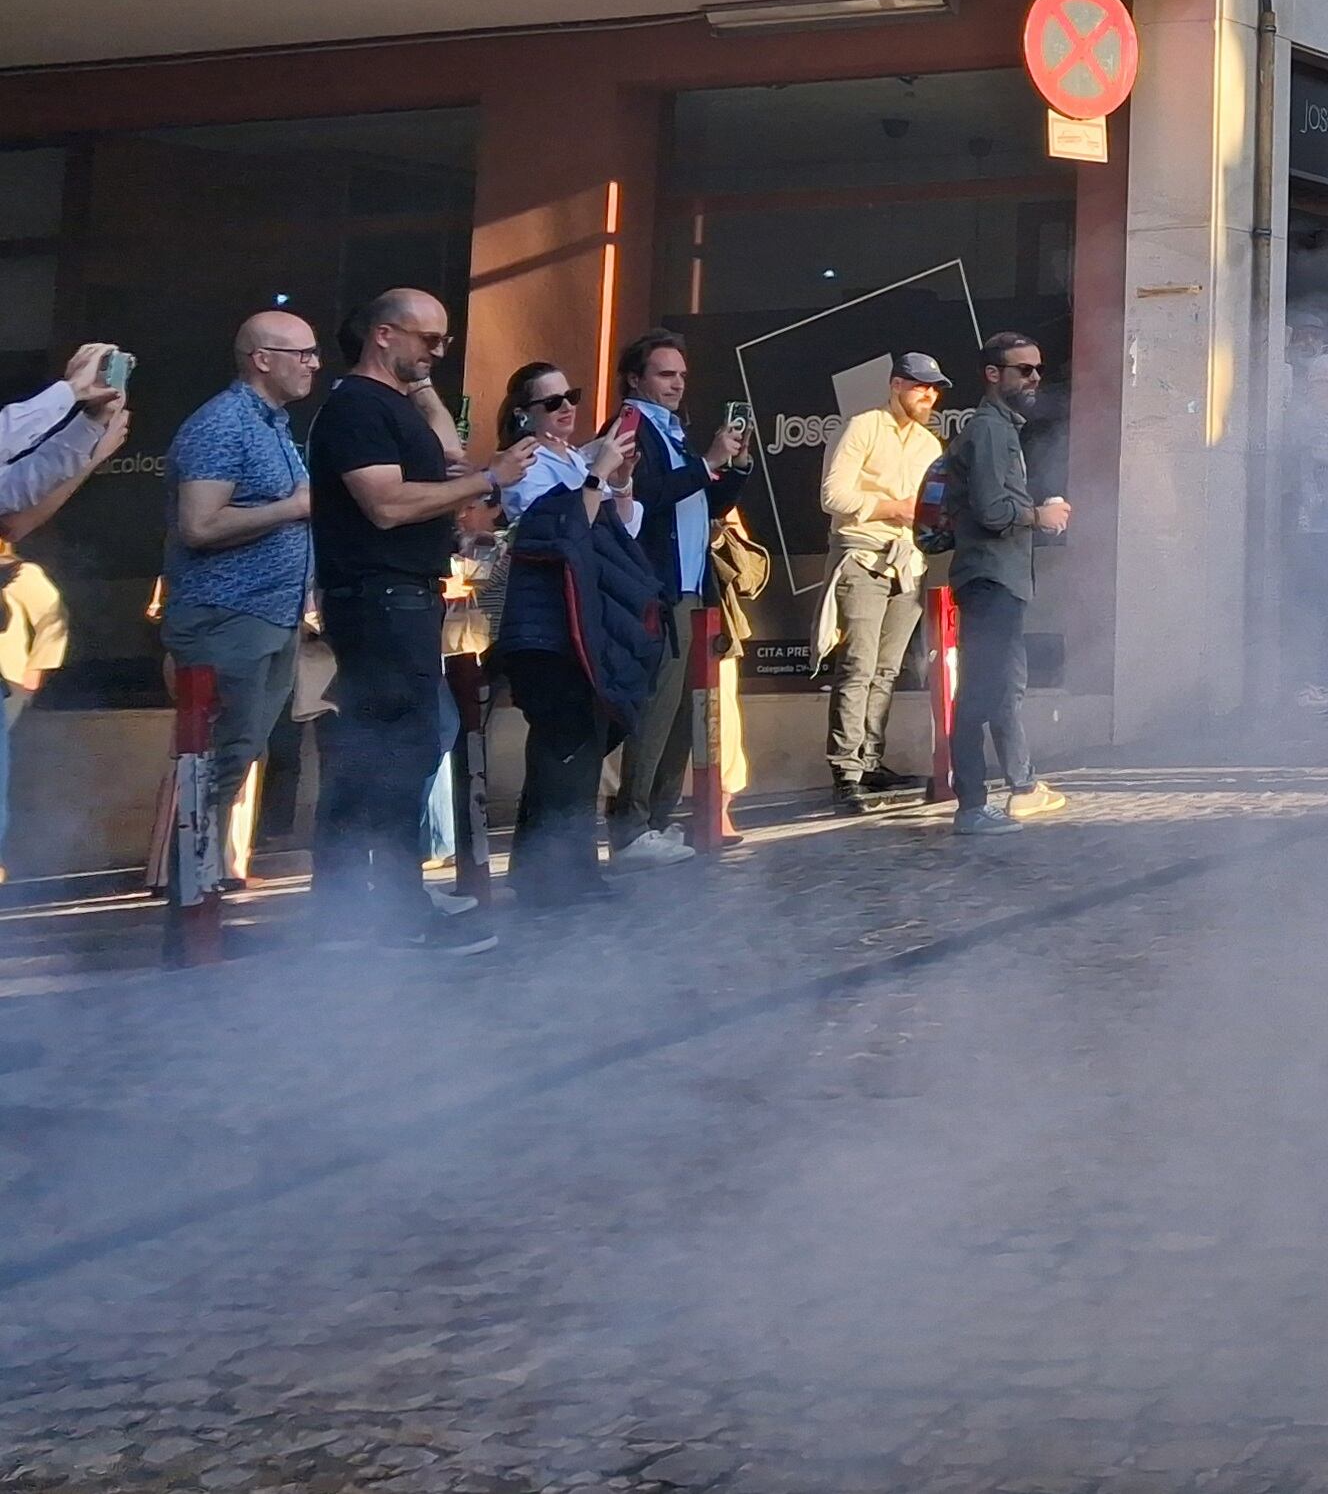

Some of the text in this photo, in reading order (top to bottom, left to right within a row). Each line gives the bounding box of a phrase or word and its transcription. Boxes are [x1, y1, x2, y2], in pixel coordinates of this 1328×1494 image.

[767, 413, 843, 455] Jose
[756, 646, 810, 658] CITA PRE
